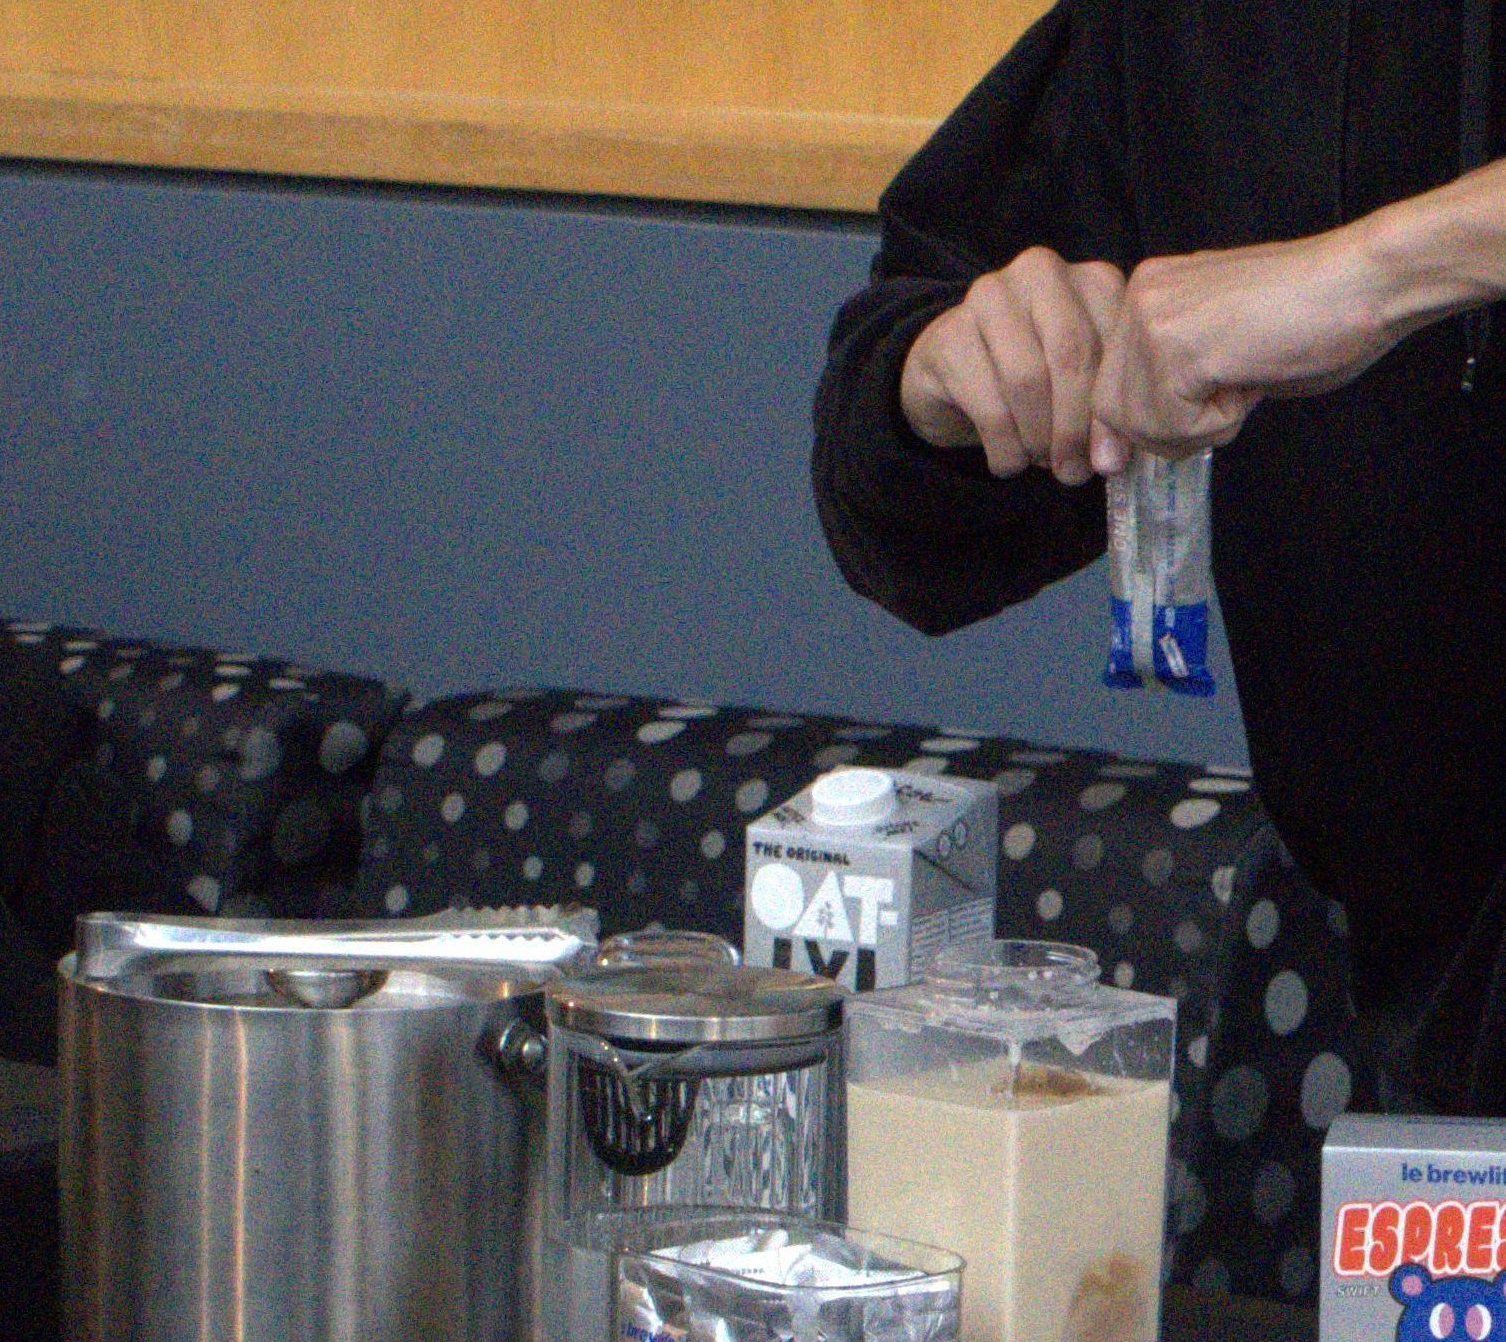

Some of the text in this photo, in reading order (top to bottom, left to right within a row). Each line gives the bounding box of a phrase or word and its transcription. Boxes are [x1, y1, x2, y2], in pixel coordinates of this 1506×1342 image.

[753, 841, 850, 867] THE ORIGINAL
[1401, 1163, 1423, 1182] le
